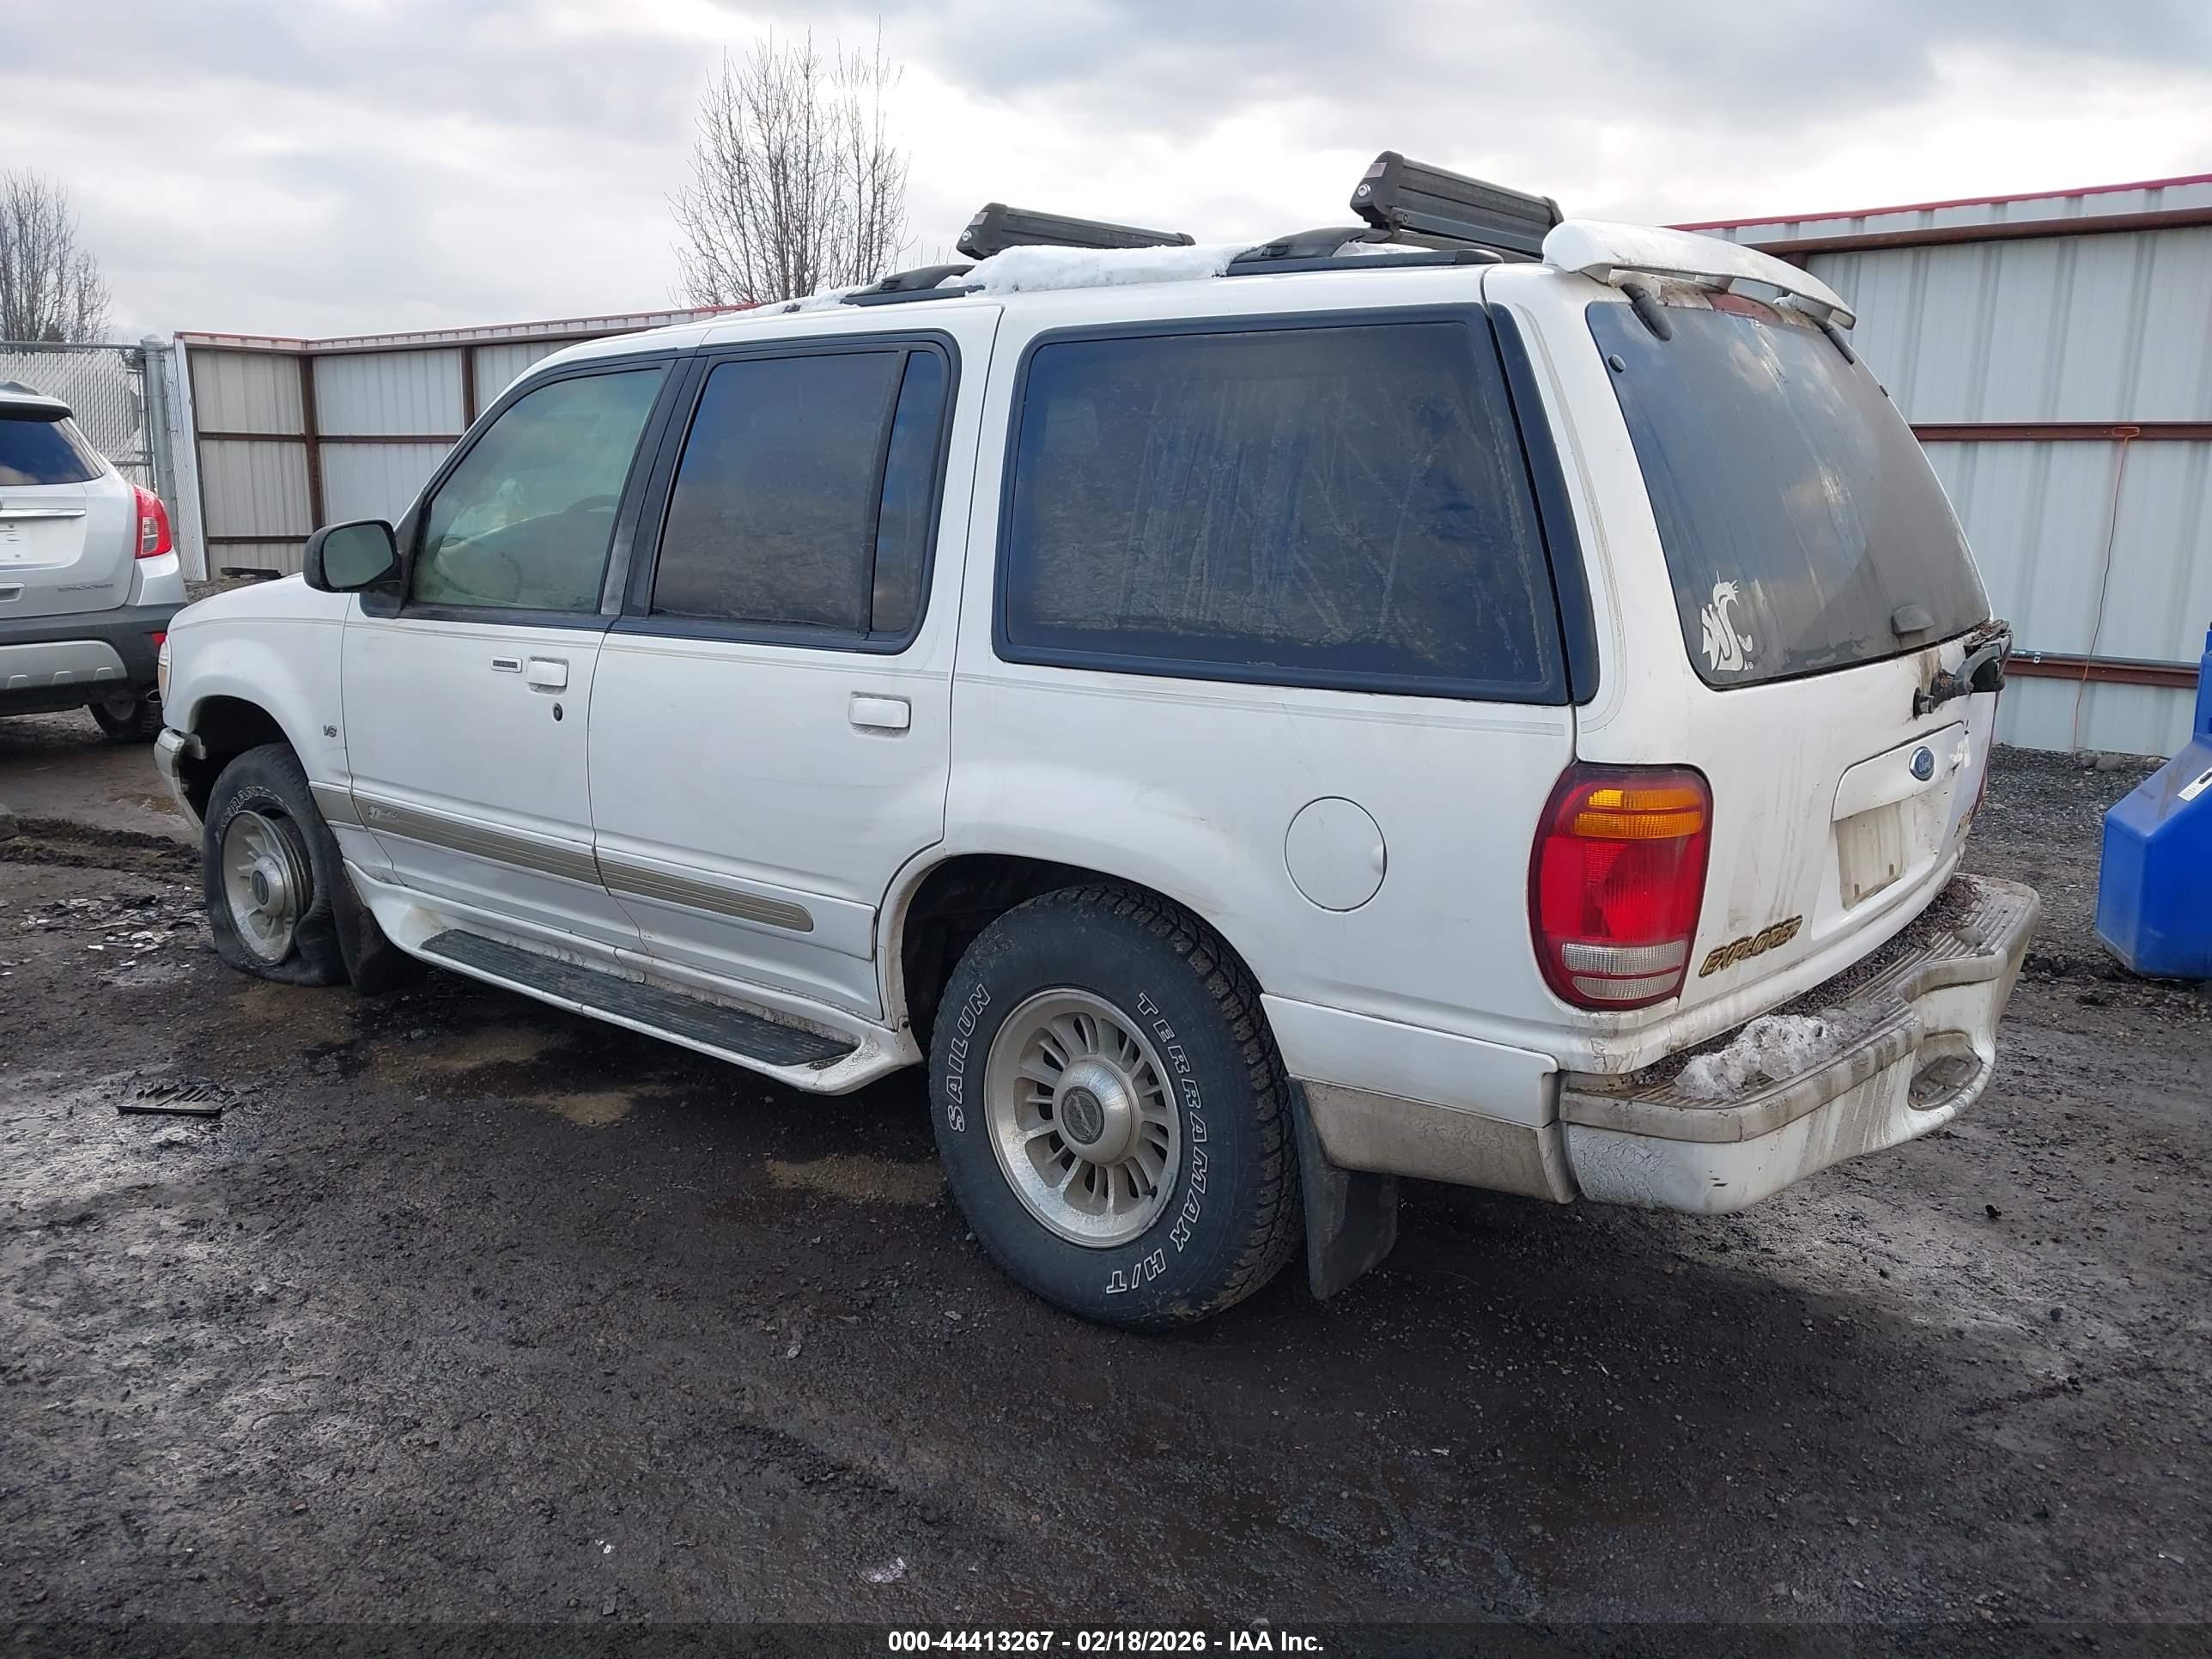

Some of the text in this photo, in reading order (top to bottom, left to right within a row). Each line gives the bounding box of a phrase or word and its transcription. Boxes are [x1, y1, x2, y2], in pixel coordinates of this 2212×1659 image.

[1698, 914, 1803, 978] EXPLORER
[946, 983, 992, 1133] SAILUN
[1105, 992, 1208, 1294] TERRAMAX H/T
